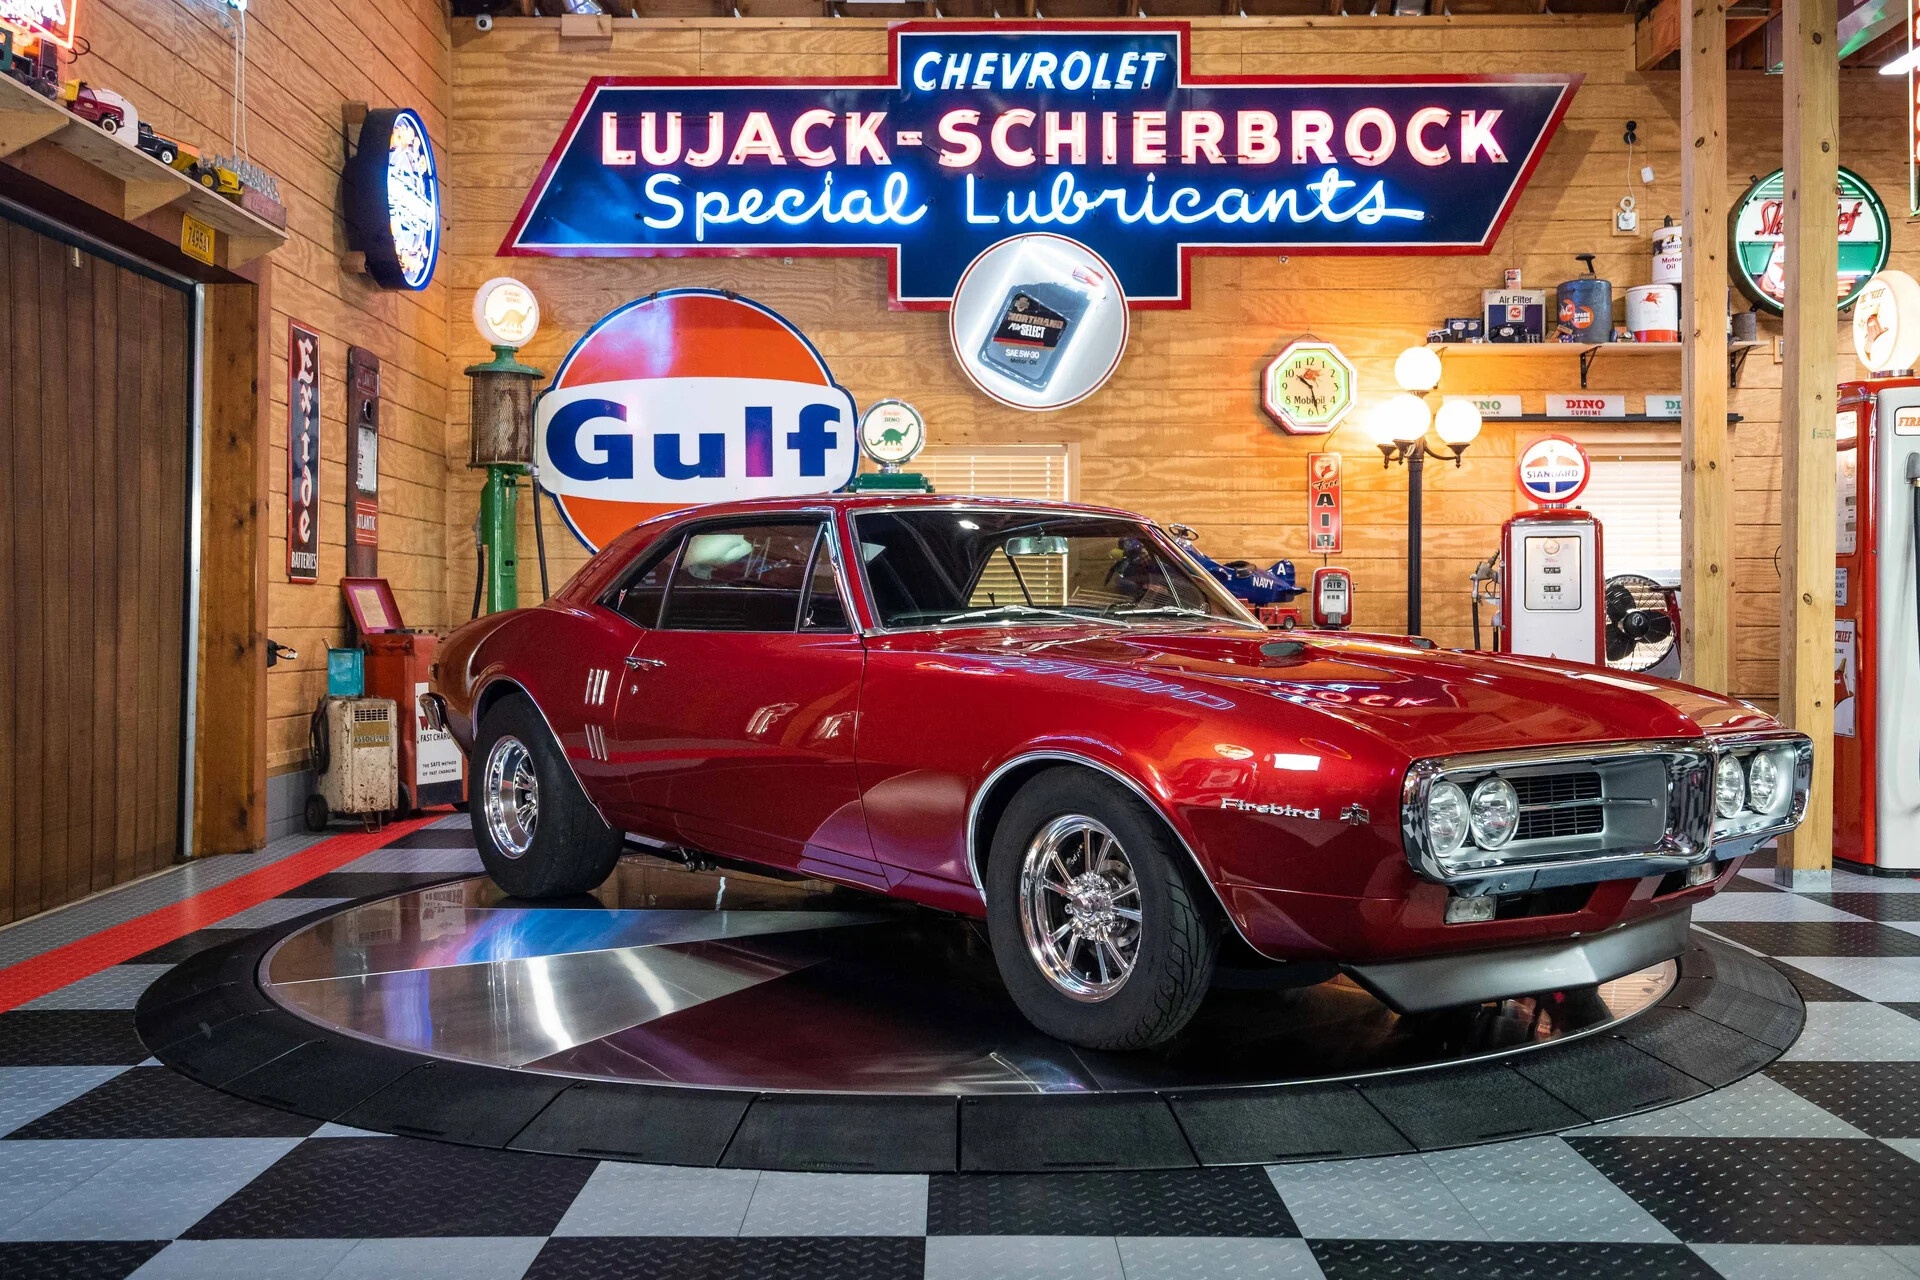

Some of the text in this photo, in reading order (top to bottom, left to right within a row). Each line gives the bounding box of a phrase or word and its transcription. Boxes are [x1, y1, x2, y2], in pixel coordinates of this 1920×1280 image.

[913, 50, 1167, 91] CHEVROLET
[601, 107, 1509, 168] LUJACK-SCHIERBROCK
[642, 166, 1426, 242] Special Lubricants
[1498, 295, 1533, 304] Air Filter
[1510, 307, 1521, 316] AC
[1020, 323, 1046, 339] SELECT
[1005, 348, 1020, 358] SAE
[1295, 361, 1301, 369] 11
[1306, 357, 1315, 366] 12
[1322, 360, 1325, 369] 1
[1285, 369, 1295, 378] 10
[1330, 369, 1336, 378] 2
[1281, 382, 1288, 391] 9
[1333, 382, 1339, 391] 3
[1285, 396, 1291, 405] 8
[1565, 399, 1605, 410] DINO
[1664, 400, 1682, 410] DI
[1295, 406, 1300, 414] 7
[1307, 408, 1314, 416] 6
[1322, 405, 1328, 413] 5
[545, 398, 841, 482] Gulf
[1526, 469, 1578, 479] STANDARD
[1311, 479, 1339, 491] Free
[356, 513, 376, 531] ATLANTIC
[1316, 492, 1336, 548] AIR
[291, 550, 317, 571] BATTERIES
[1276, 562, 1287, 576] A
[1252, 576, 1275, 590] NAVY
[1326, 581, 1342, 589] AIR
[420, 730, 451, 743] FAST CHARG
[1220, 796, 1321, 820] Firebird
